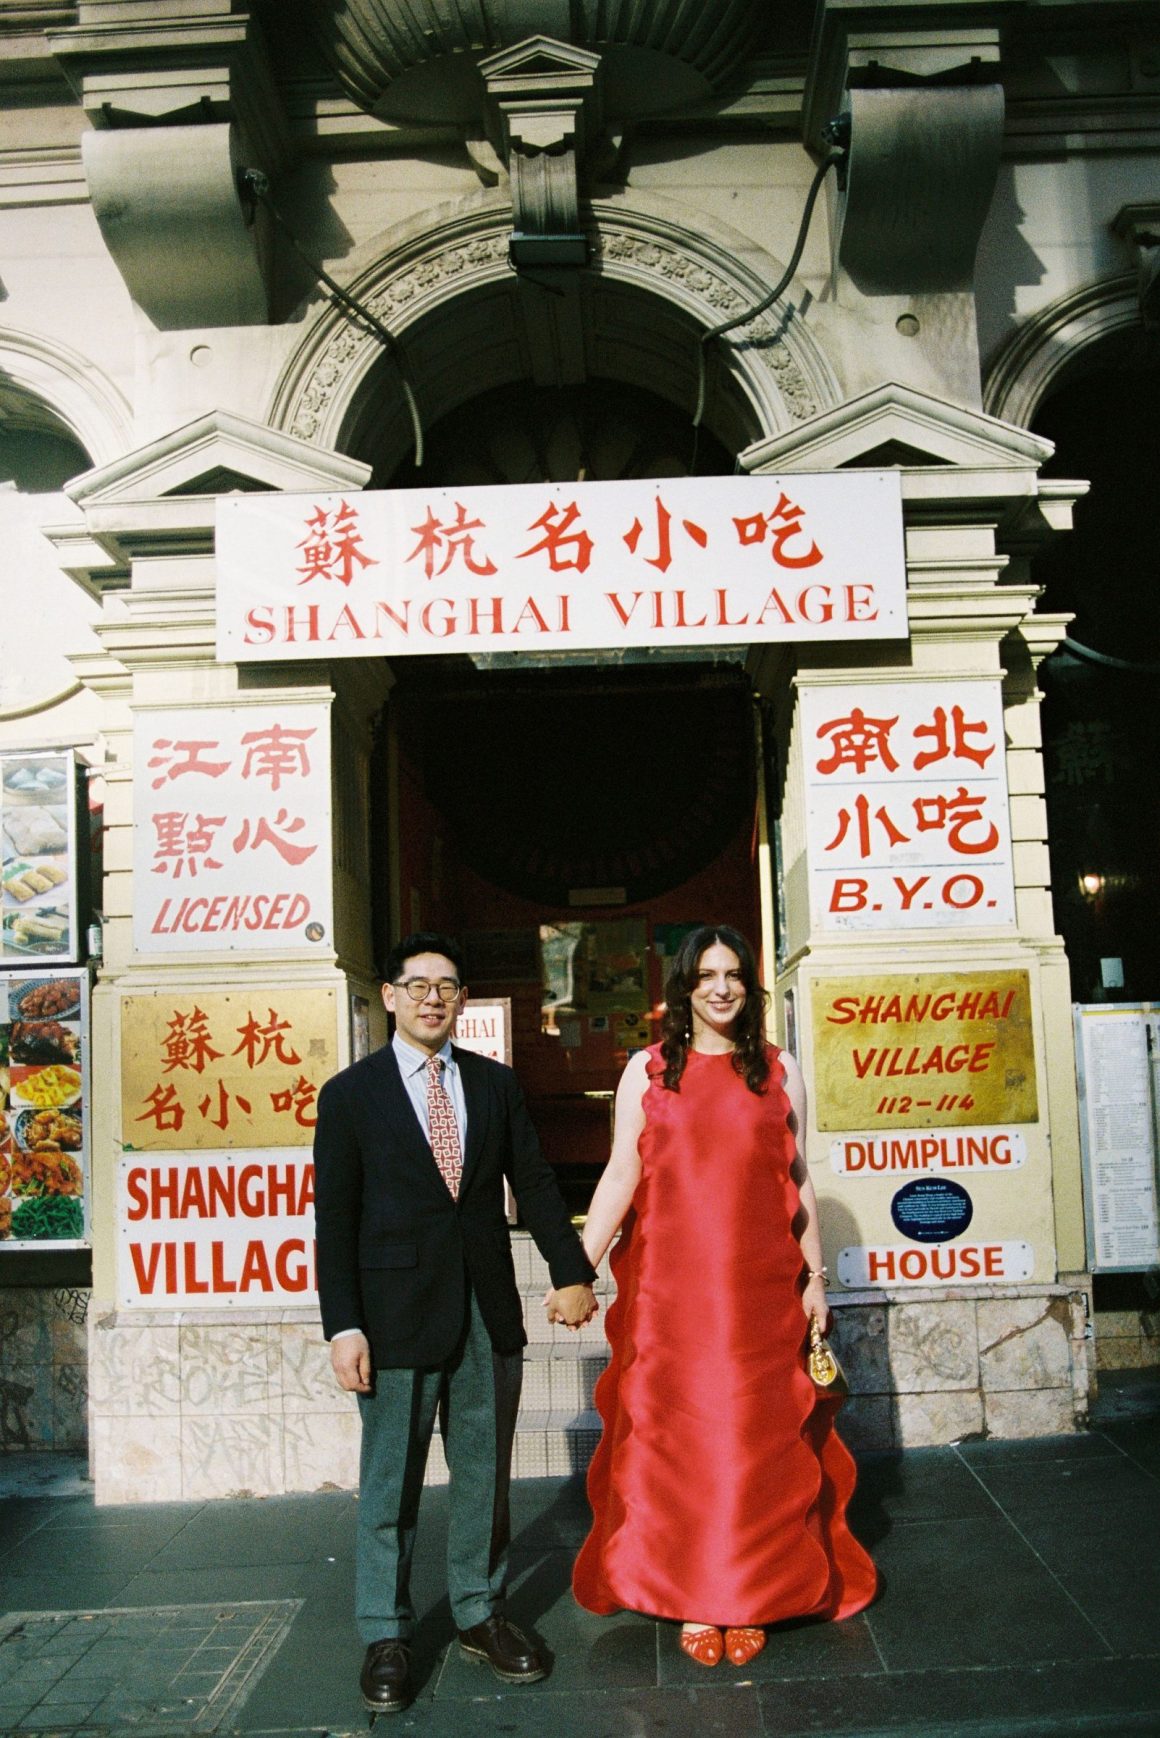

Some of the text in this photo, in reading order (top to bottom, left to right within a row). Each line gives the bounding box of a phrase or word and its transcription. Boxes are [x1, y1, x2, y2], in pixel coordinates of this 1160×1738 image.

[295, 492, 824, 588] 蘇杭名小吃
[243, 584, 880, 645] SHANGHAI VILLAGE
[147, 723, 318, 792] 江南
[815, 704, 996, 775] 南北
[150, 807, 318, 879] 點心
[823, 786, 1000, 859] 小吃
[151, 893, 311, 934] LICENSED
[828, 873, 998, 913] B.Y.O.
[450, 1017, 496, 1039] GHAI
[826, 990, 1016, 1025] SHANGHAI
[160, 1005, 302, 1074] 蘇杭
[851, 1041, 996, 1079] VILLAGE
[134, 1074, 318, 1132] 名小吃
[875, 1094, 975, 1115] 112-114
[843, 1134, 1012, 1172] DUMPLING
[126, 1163, 317, 1221] SHANGHA
[129, 1238, 319, 1295] VILLAG
[867, 1245, 1005, 1282] HOUSE
